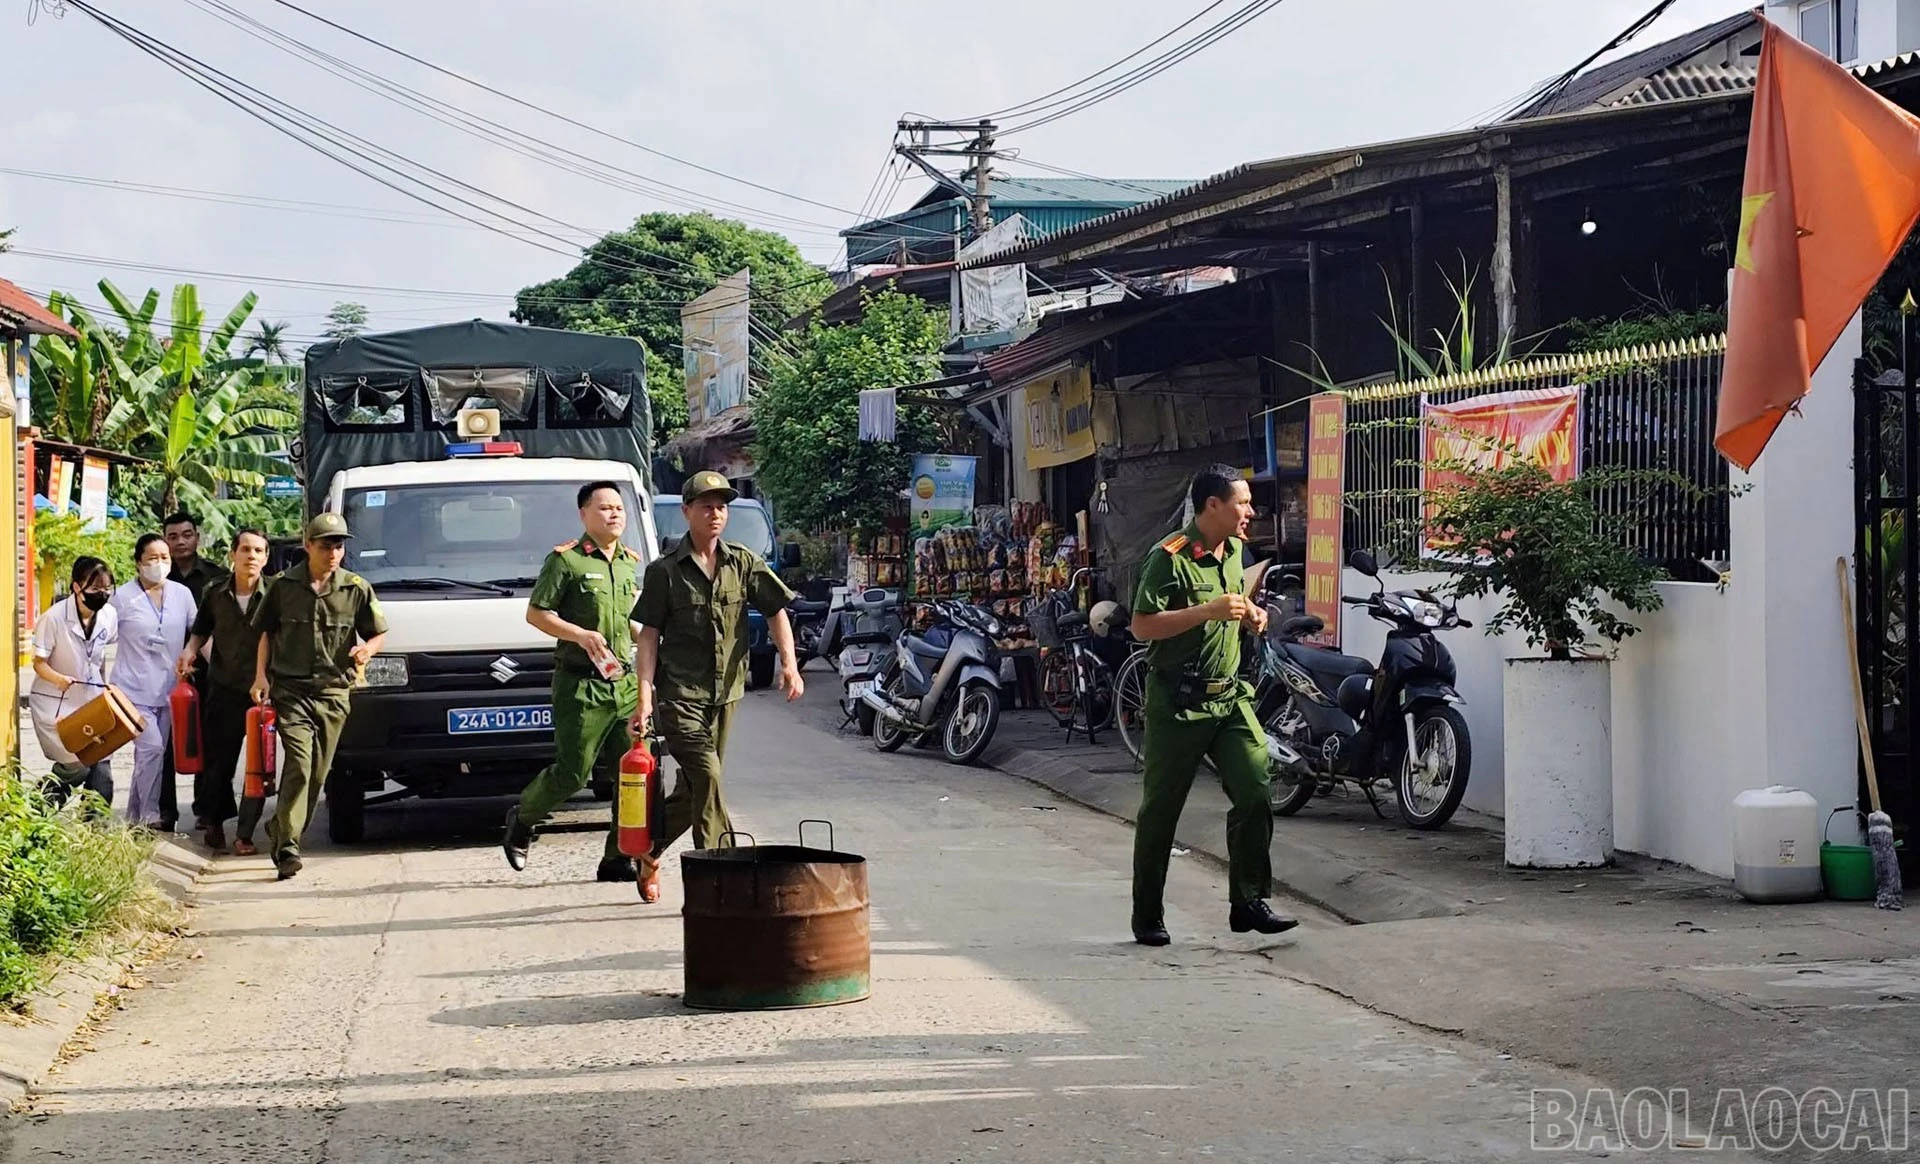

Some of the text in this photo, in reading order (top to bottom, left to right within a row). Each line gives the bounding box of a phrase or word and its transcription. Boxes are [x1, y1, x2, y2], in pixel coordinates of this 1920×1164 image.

[1310, 529, 1335, 563] KHÔNG
[1308, 573, 1320, 602] MA
[458, 710, 552, 729] 24A-012.08
